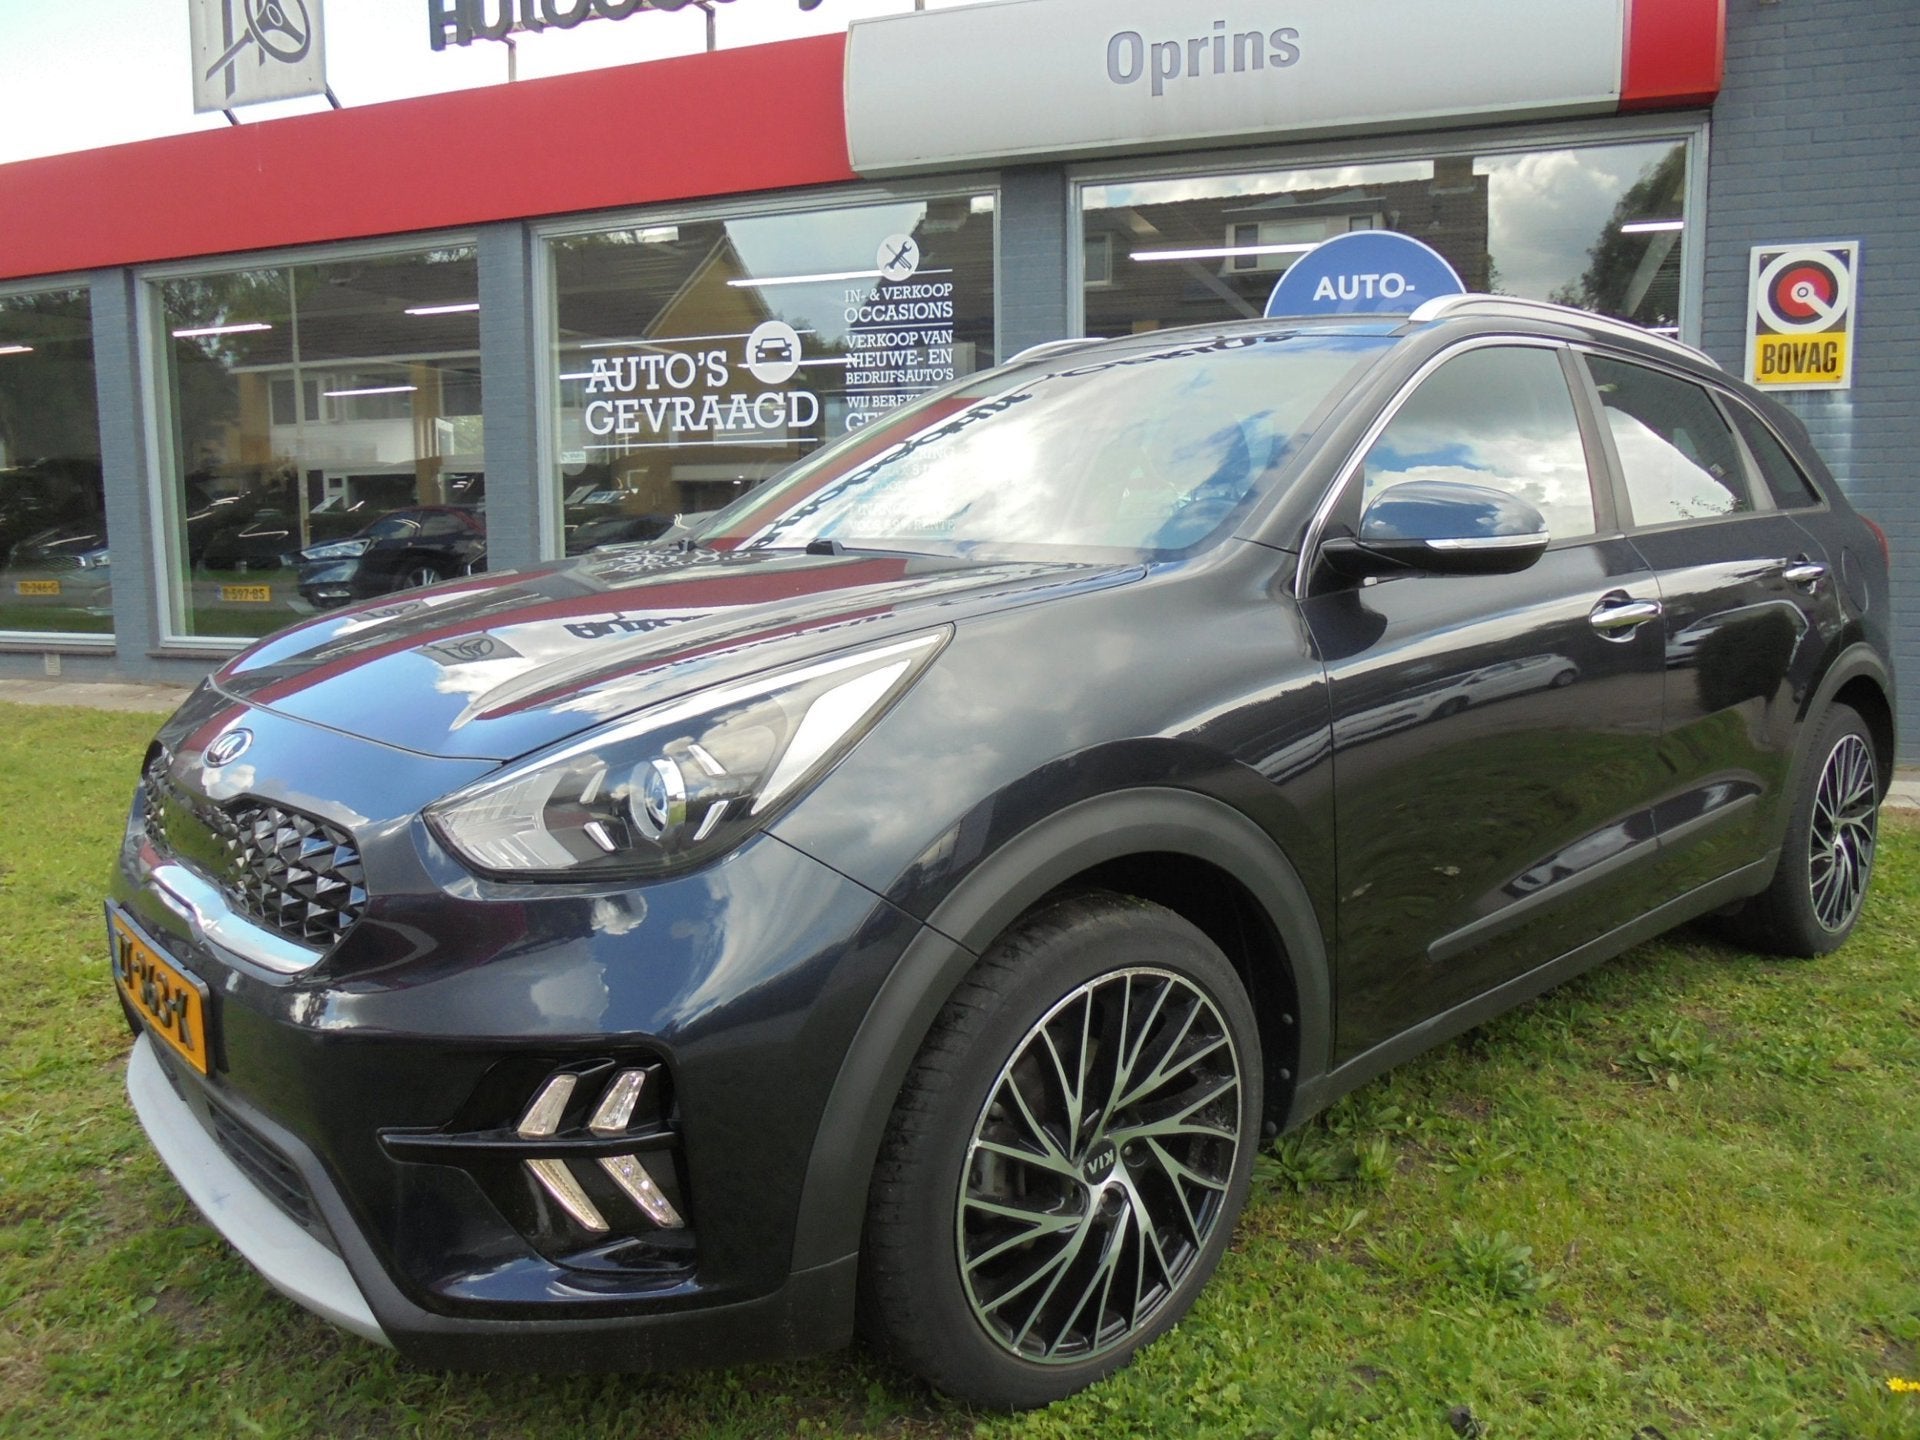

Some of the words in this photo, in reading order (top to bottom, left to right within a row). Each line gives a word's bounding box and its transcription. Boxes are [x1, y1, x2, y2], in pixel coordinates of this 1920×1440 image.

[1107, 20, 1300, 97] Oprins
[882, 283, 953, 300] VERKOOP
[1313, 273, 1415, 301] AUTO-
[844, 301, 953, 323] OCCASIONS
[846, 332, 918, 348] VERKOOP
[921, 330, 953, 344] VAN
[845, 350, 924, 368] NIEUWE-
[928, 348, 953, 364] EN
[1761, 341, 1838, 374] BOVAG
[585, 350, 729, 393] AUTO'S
[845, 368, 954, 385] BEDRIJFSAUTO'S
[585, 391, 819, 435] GEVRAAGD
[846, 396, 870, 408] WIJ
